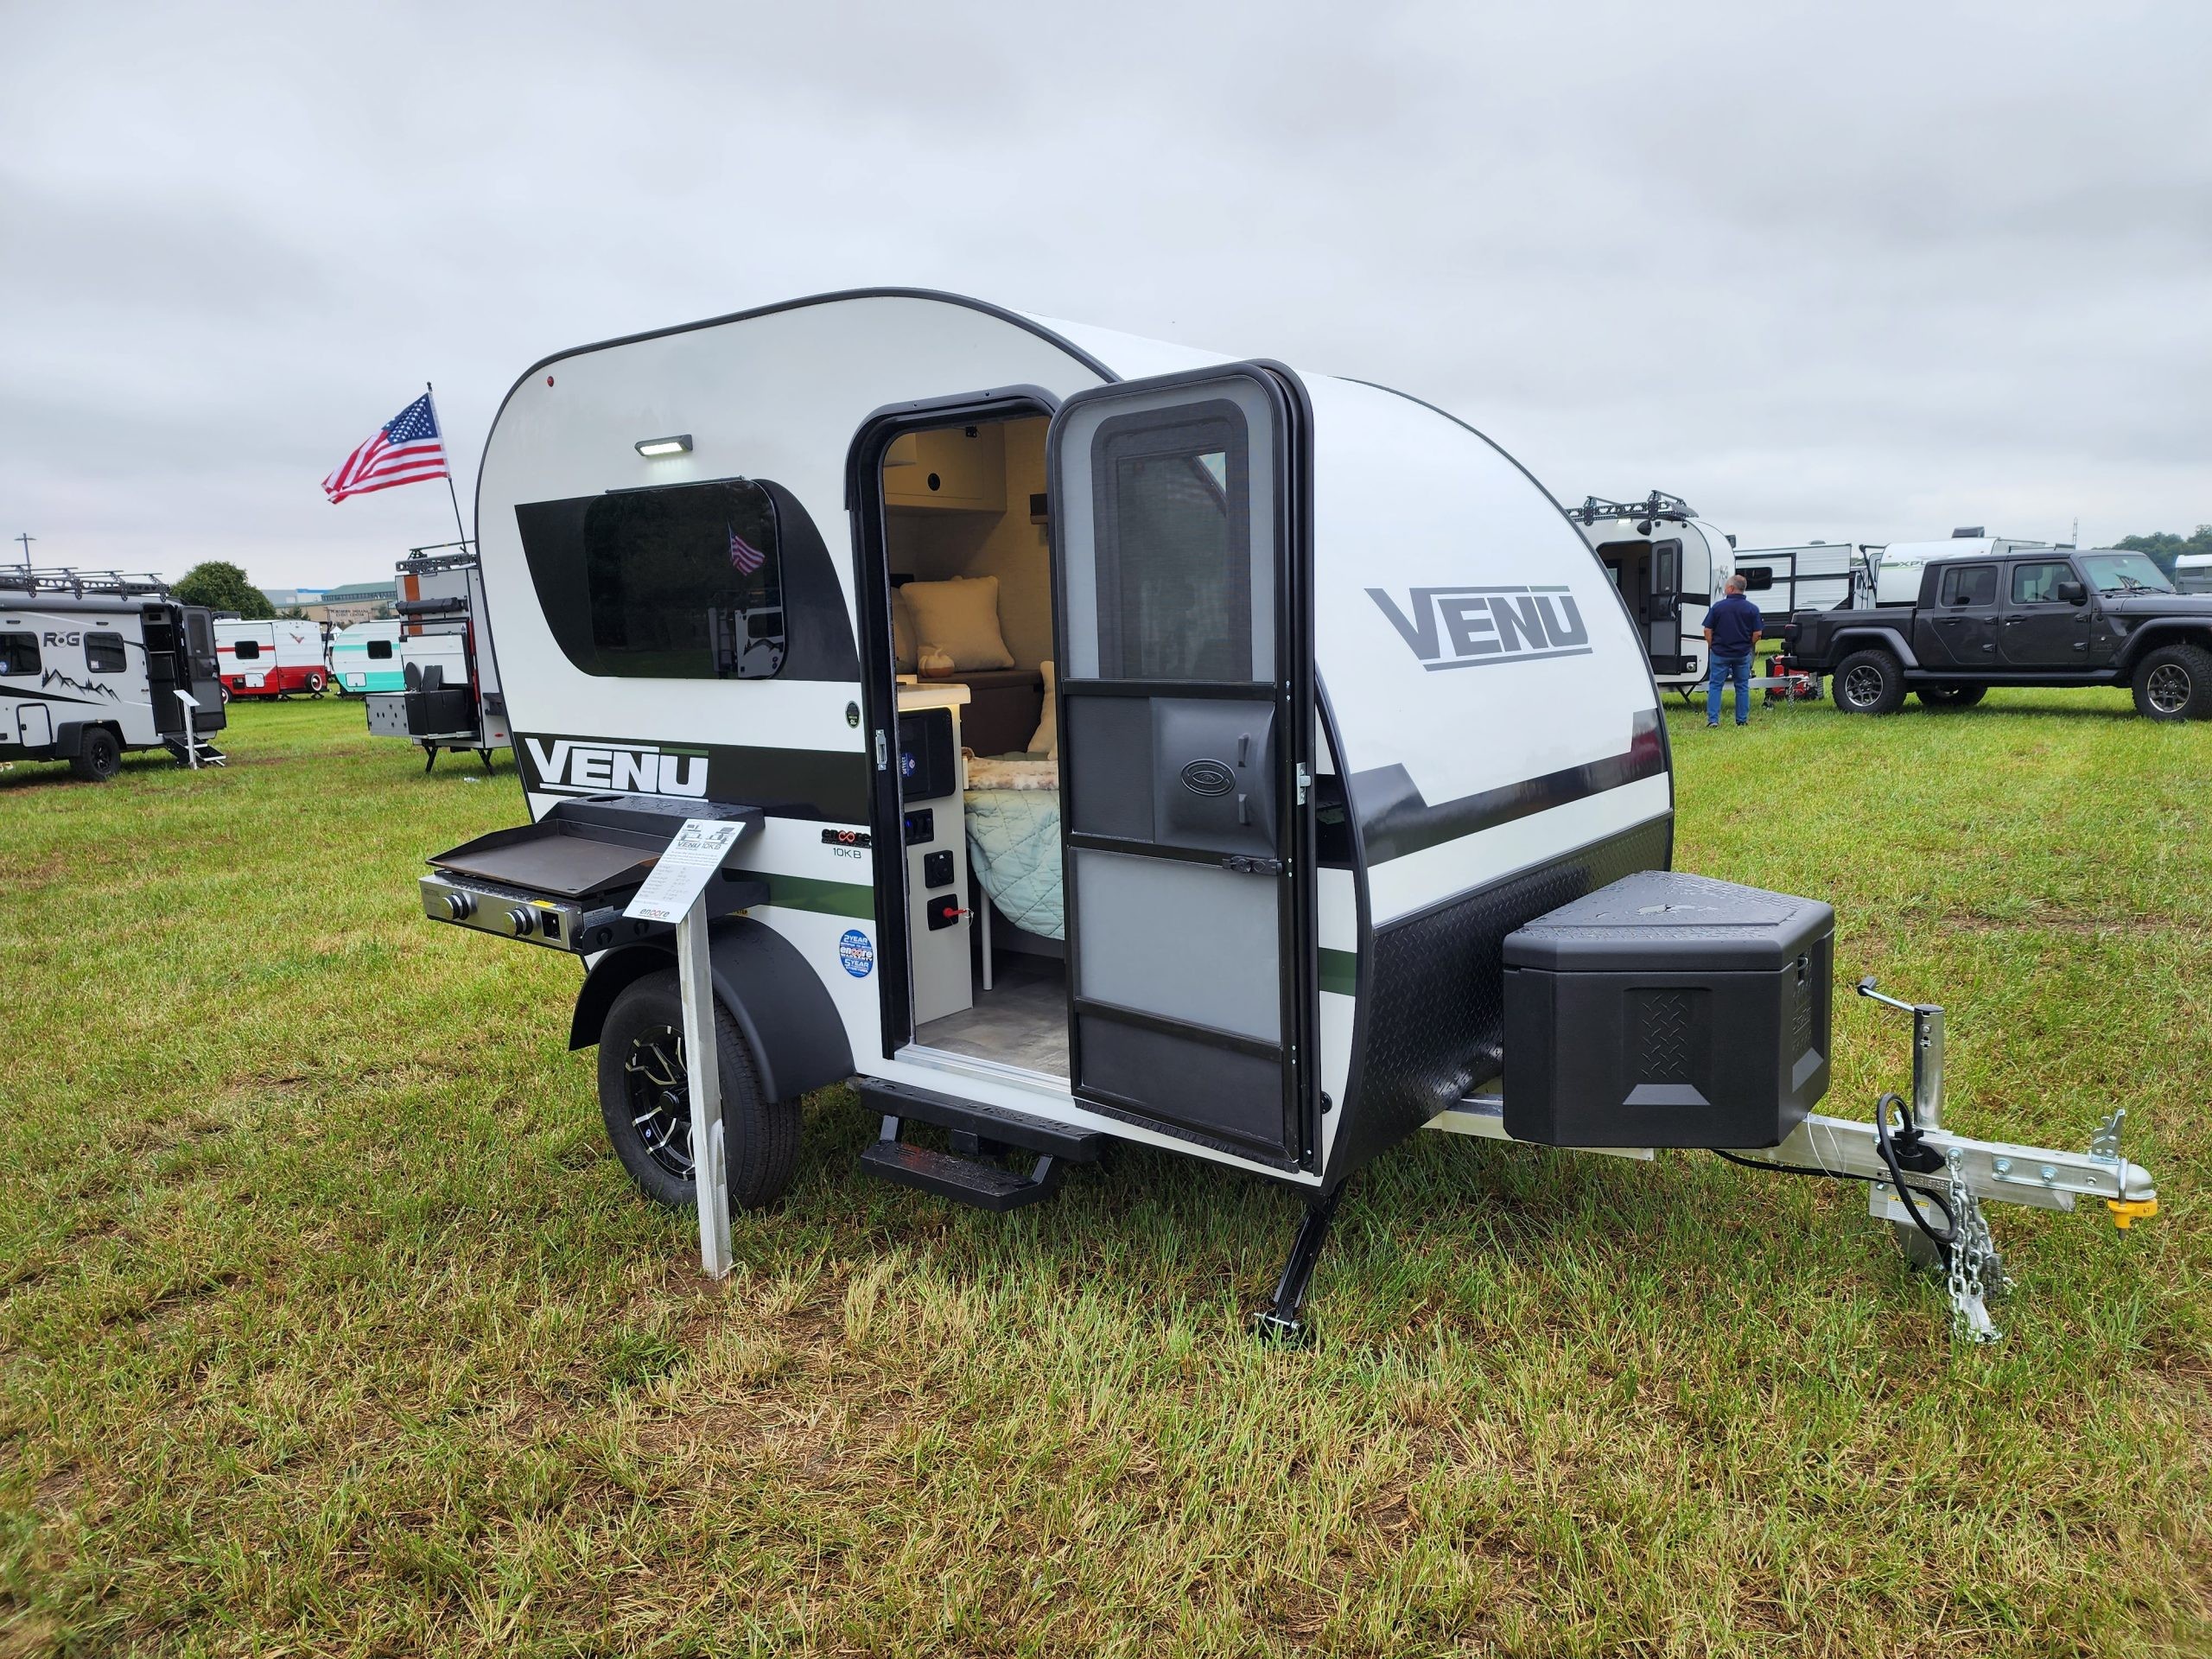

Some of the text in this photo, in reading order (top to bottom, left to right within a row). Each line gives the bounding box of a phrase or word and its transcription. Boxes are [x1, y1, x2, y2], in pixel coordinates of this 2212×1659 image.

[1363, 585, 1589, 661] VENU
[524, 737, 709, 798] VENU
[833, 847, 862, 859] 10KB
